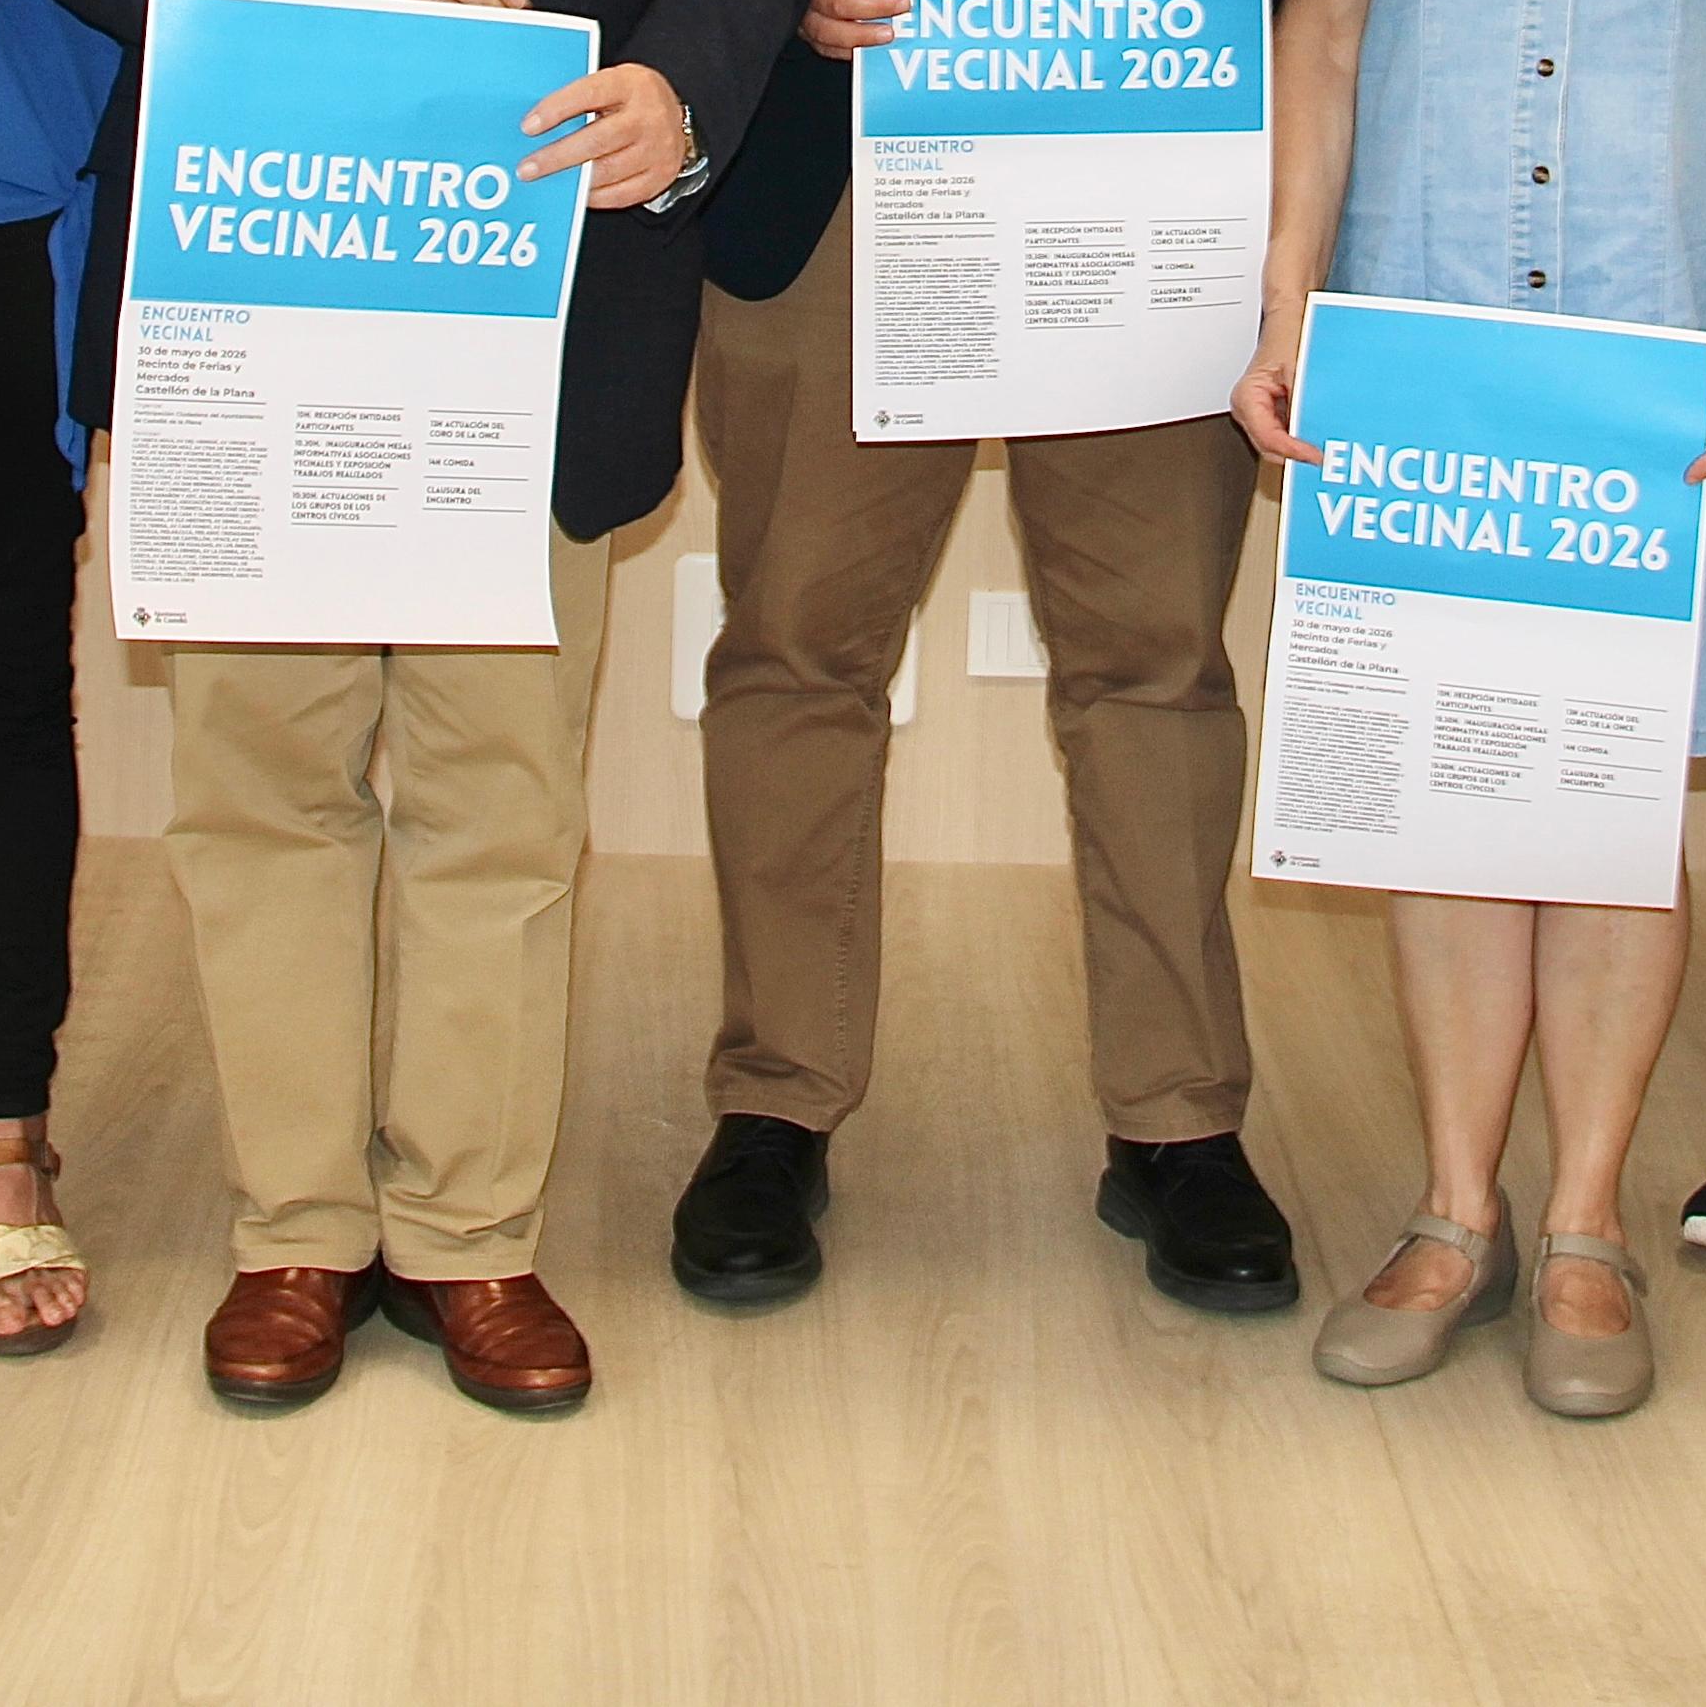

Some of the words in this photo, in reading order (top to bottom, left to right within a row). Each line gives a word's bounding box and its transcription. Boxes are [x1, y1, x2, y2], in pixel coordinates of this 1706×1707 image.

[887, 46, 1106, 91] VECINAL
[1121, 47, 1238, 89] 2026
[875, 140, 973, 154] ENCUENTRO
[875, 158, 943, 171] VECINAL
[175, 144, 510, 210] ENCUENTRO
[935, 177, 948, 185] de
[875, 188, 913, 197] Recinto
[915, 189, 929, 197] de
[931, 188, 962, 196] Ferias
[964, 190, 970, 198] y
[874, 200, 924, 209] Mercados
[927, 212, 941, 220] de
[943, 211, 953, 219] la
[955, 211, 985, 219] Plana
[169, 203, 397, 261] VECINAL
[413, 218, 538, 267] 2026
[142, 306, 250, 324] ENCUENTRO
[141, 325, 213, 342] VECINAL
[154, 346, 168, 356] de
[171, 349, 202, 359] mayo
[204, 349, 218, 358] de
[137, 359, 180, 369] Recinto
[182, 361, 197, 370] de
[199, 361, 232, 371] Ferias
[234, 365, 242, 374] y
[137, 372, 190, 383] Mercados
[192, 387, 207, 396] de
[210, 387, 220, 397] la
[223, 388, 255, 398] Plana
[1318, 440, 1640, 514] ENCUENTRO
[1317, 493, 1532, 557] VECINAL
[1547, 518, 1670, 571] 2026
[1297, 583, 1396, 606] ENCUENTRO
[1296, 601, 1362, 620] VECINAL
